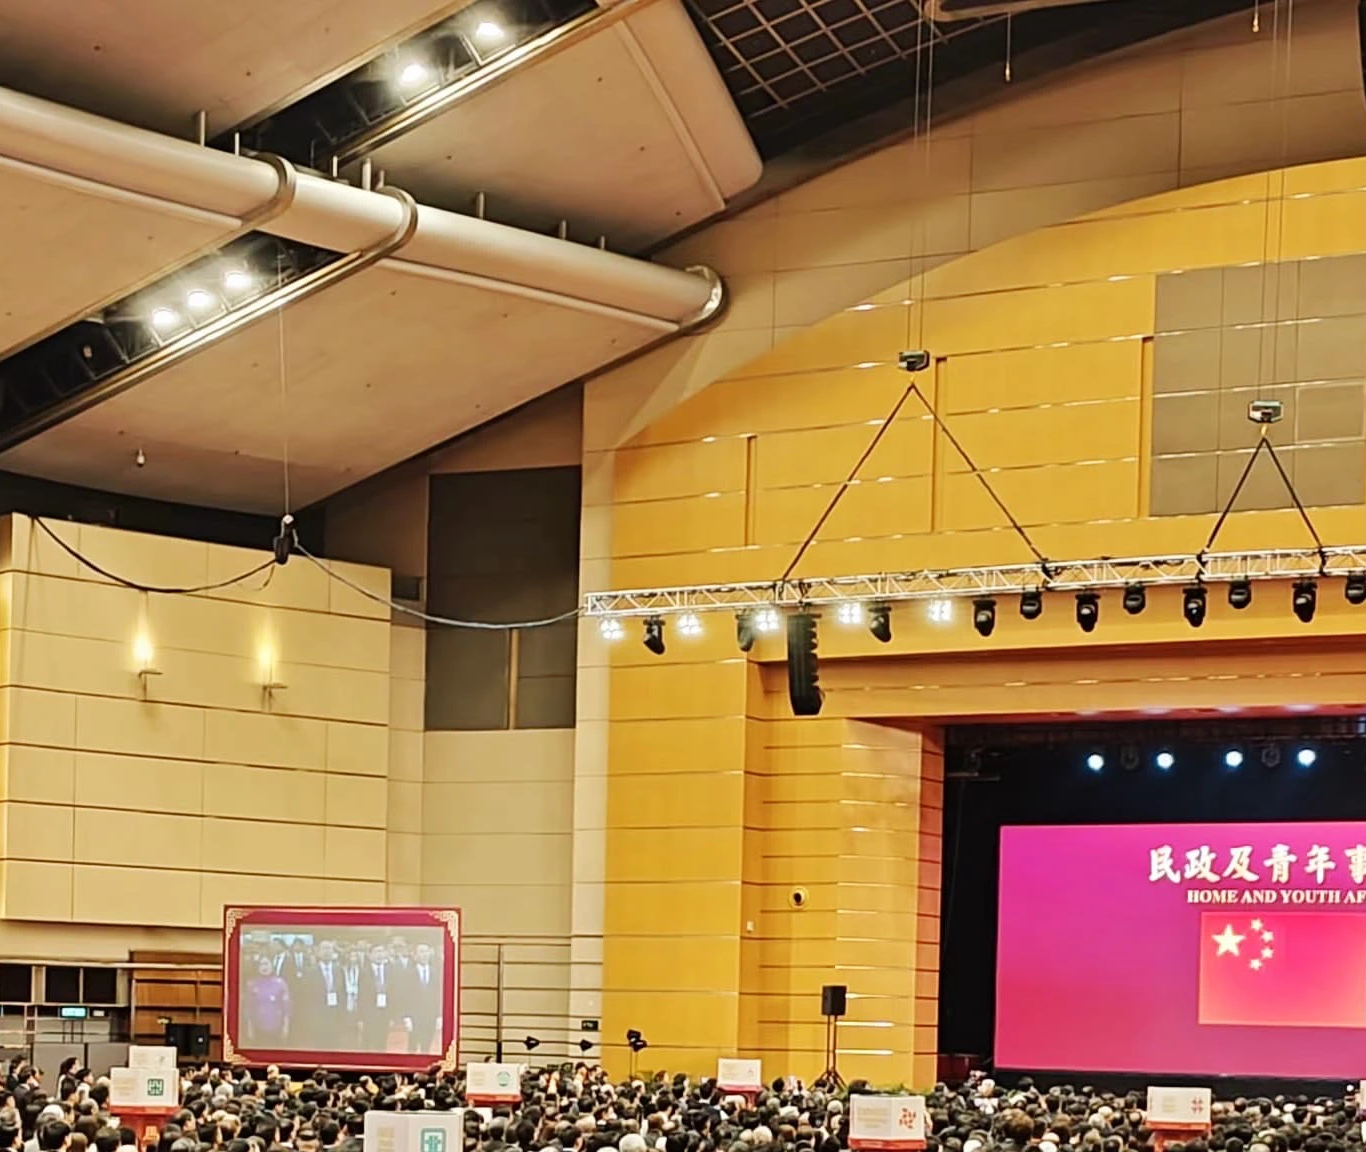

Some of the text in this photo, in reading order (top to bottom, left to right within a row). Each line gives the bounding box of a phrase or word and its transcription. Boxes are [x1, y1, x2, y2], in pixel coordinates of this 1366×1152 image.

[1187, 889, 1238, 905] HOME
[1241, 889, 1277, 905] AND
[1280, 889, 1339, 905] YOUTH
